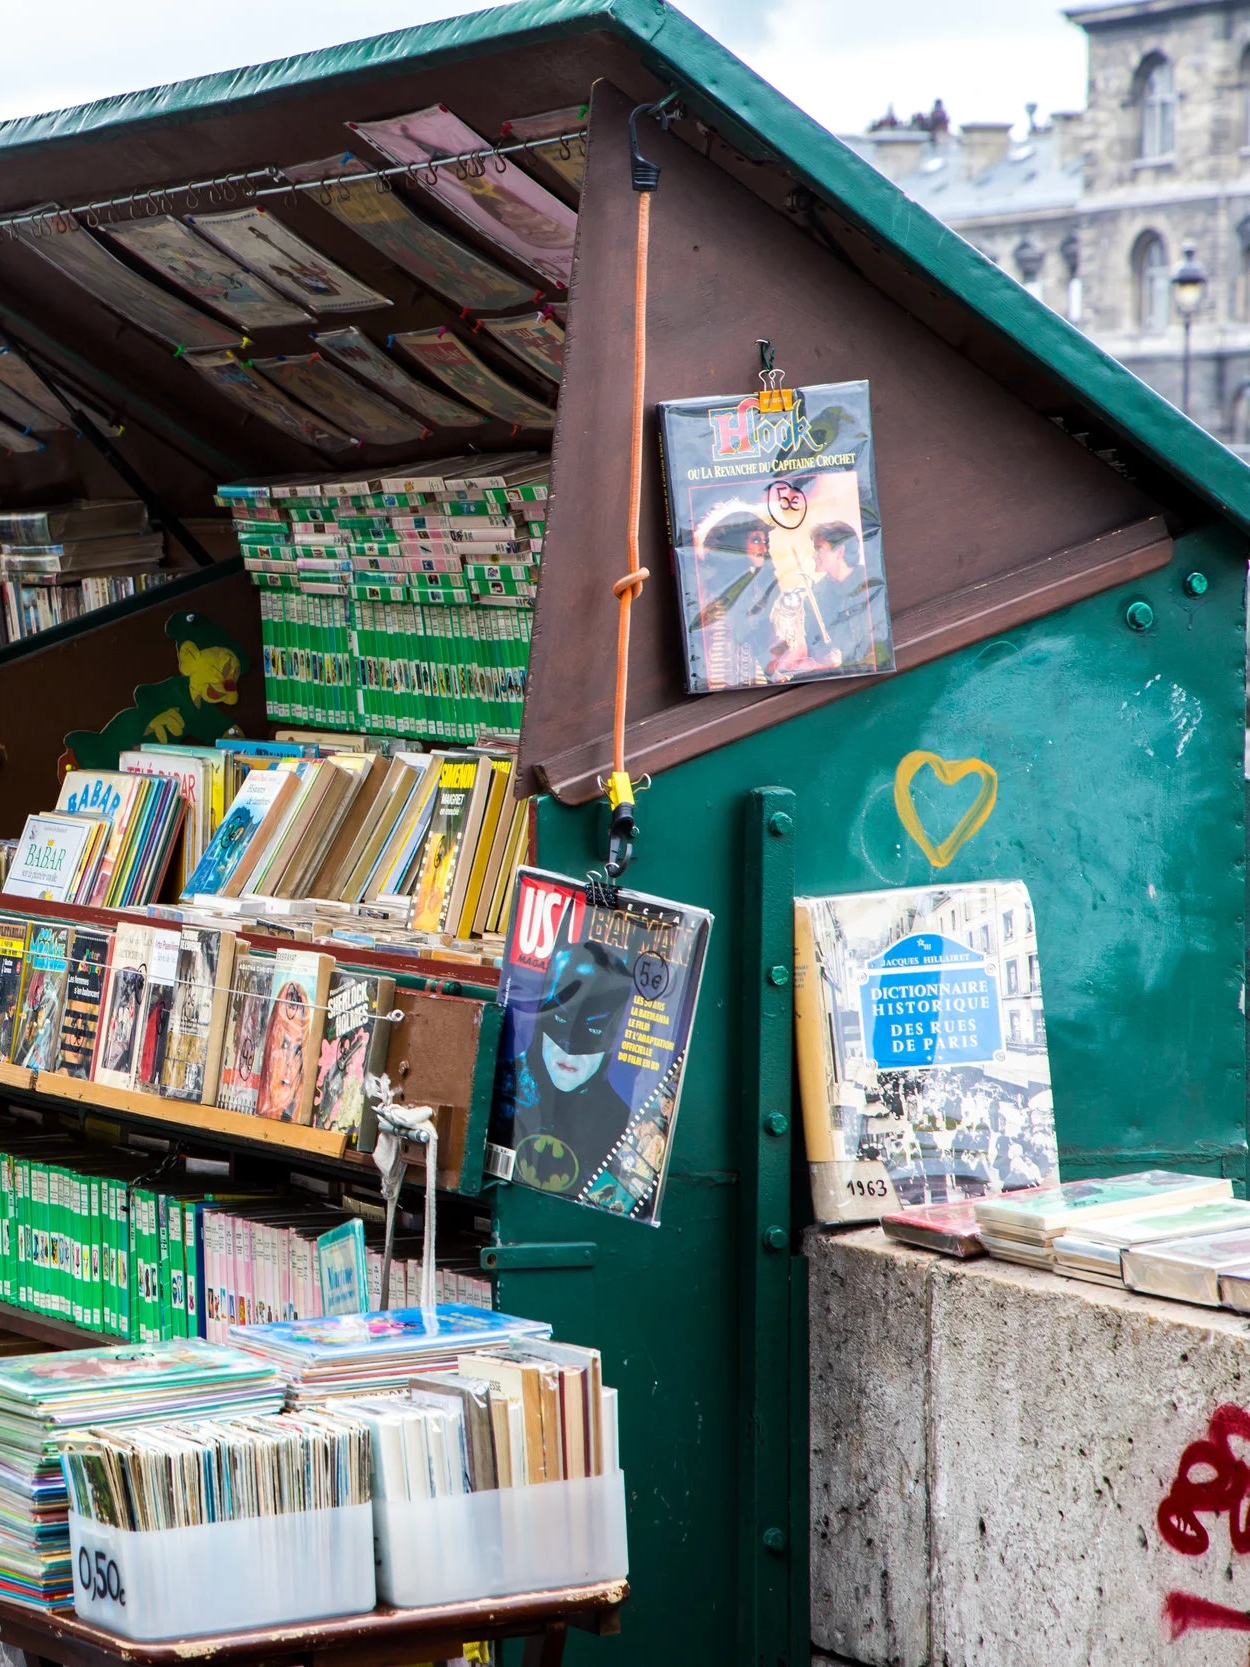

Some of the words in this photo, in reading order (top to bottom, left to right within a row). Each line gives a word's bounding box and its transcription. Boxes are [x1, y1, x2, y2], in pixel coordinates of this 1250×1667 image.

[710, 398, 824, 460] Hook
[687, 469, 700, 480] OU
[701, 467, 713, 479] LA
[714, 463, 758, 478] REVANCHE
[759, 462, 771, 472] DU
[771, 456, 815, 472] CAPITAINE
[816, 452, 857, 467] CROCHET
[777, 487, 800, 511] 5€
[438, 763, 477, 789] SIMENON
[67, 779, 122, 816] BABAR
[440, 793, 466, 805] MAIGRET
[24, 843, 67, 872] BABAR
[239, 963, 257, 972] AGATHA
[257, 966, 275, 974] CHRISTI
[881, 956, 919, 967] JACQUES
[923, 953, 970, 964] HILLAIRET
[639, 962, 663, 990] 5€
[327, 980, 370, 1020] SHERLOCK
[871, 980, 989, 1001] DICTIONNAIRE
[633, 995, 643, 1005] LES
[652, 1000, 666, 1011] ANS
[872, 996, 990, 1017] HISTORIQUE
[335, 1002, 370, 1038] HOLMES
[627, 1018, 635, 1028] LE
[635, 1020, 651, 1032] FILM
[630, 1006, 638, 1016] LA
[639, 1008, 670, 1025] BATMANIA
[890, 1022, 924, 1037] DES
[931, 1018, 977, 1035] RUES
[621, 1041, 653, 1057] OFFICIELLE
[624, 1029, 632, 1039] ET
[632, 1030, 675, 1051] L'ADAPTATION
[892, 1039, 916, 1053] DE
[923, 1035, 979, 1051] PARIS
[618, 1051, 627, 1062] DU
[628, 1054, 642, 1066] FILM
[846, 1178, 888, 1198] 1963
